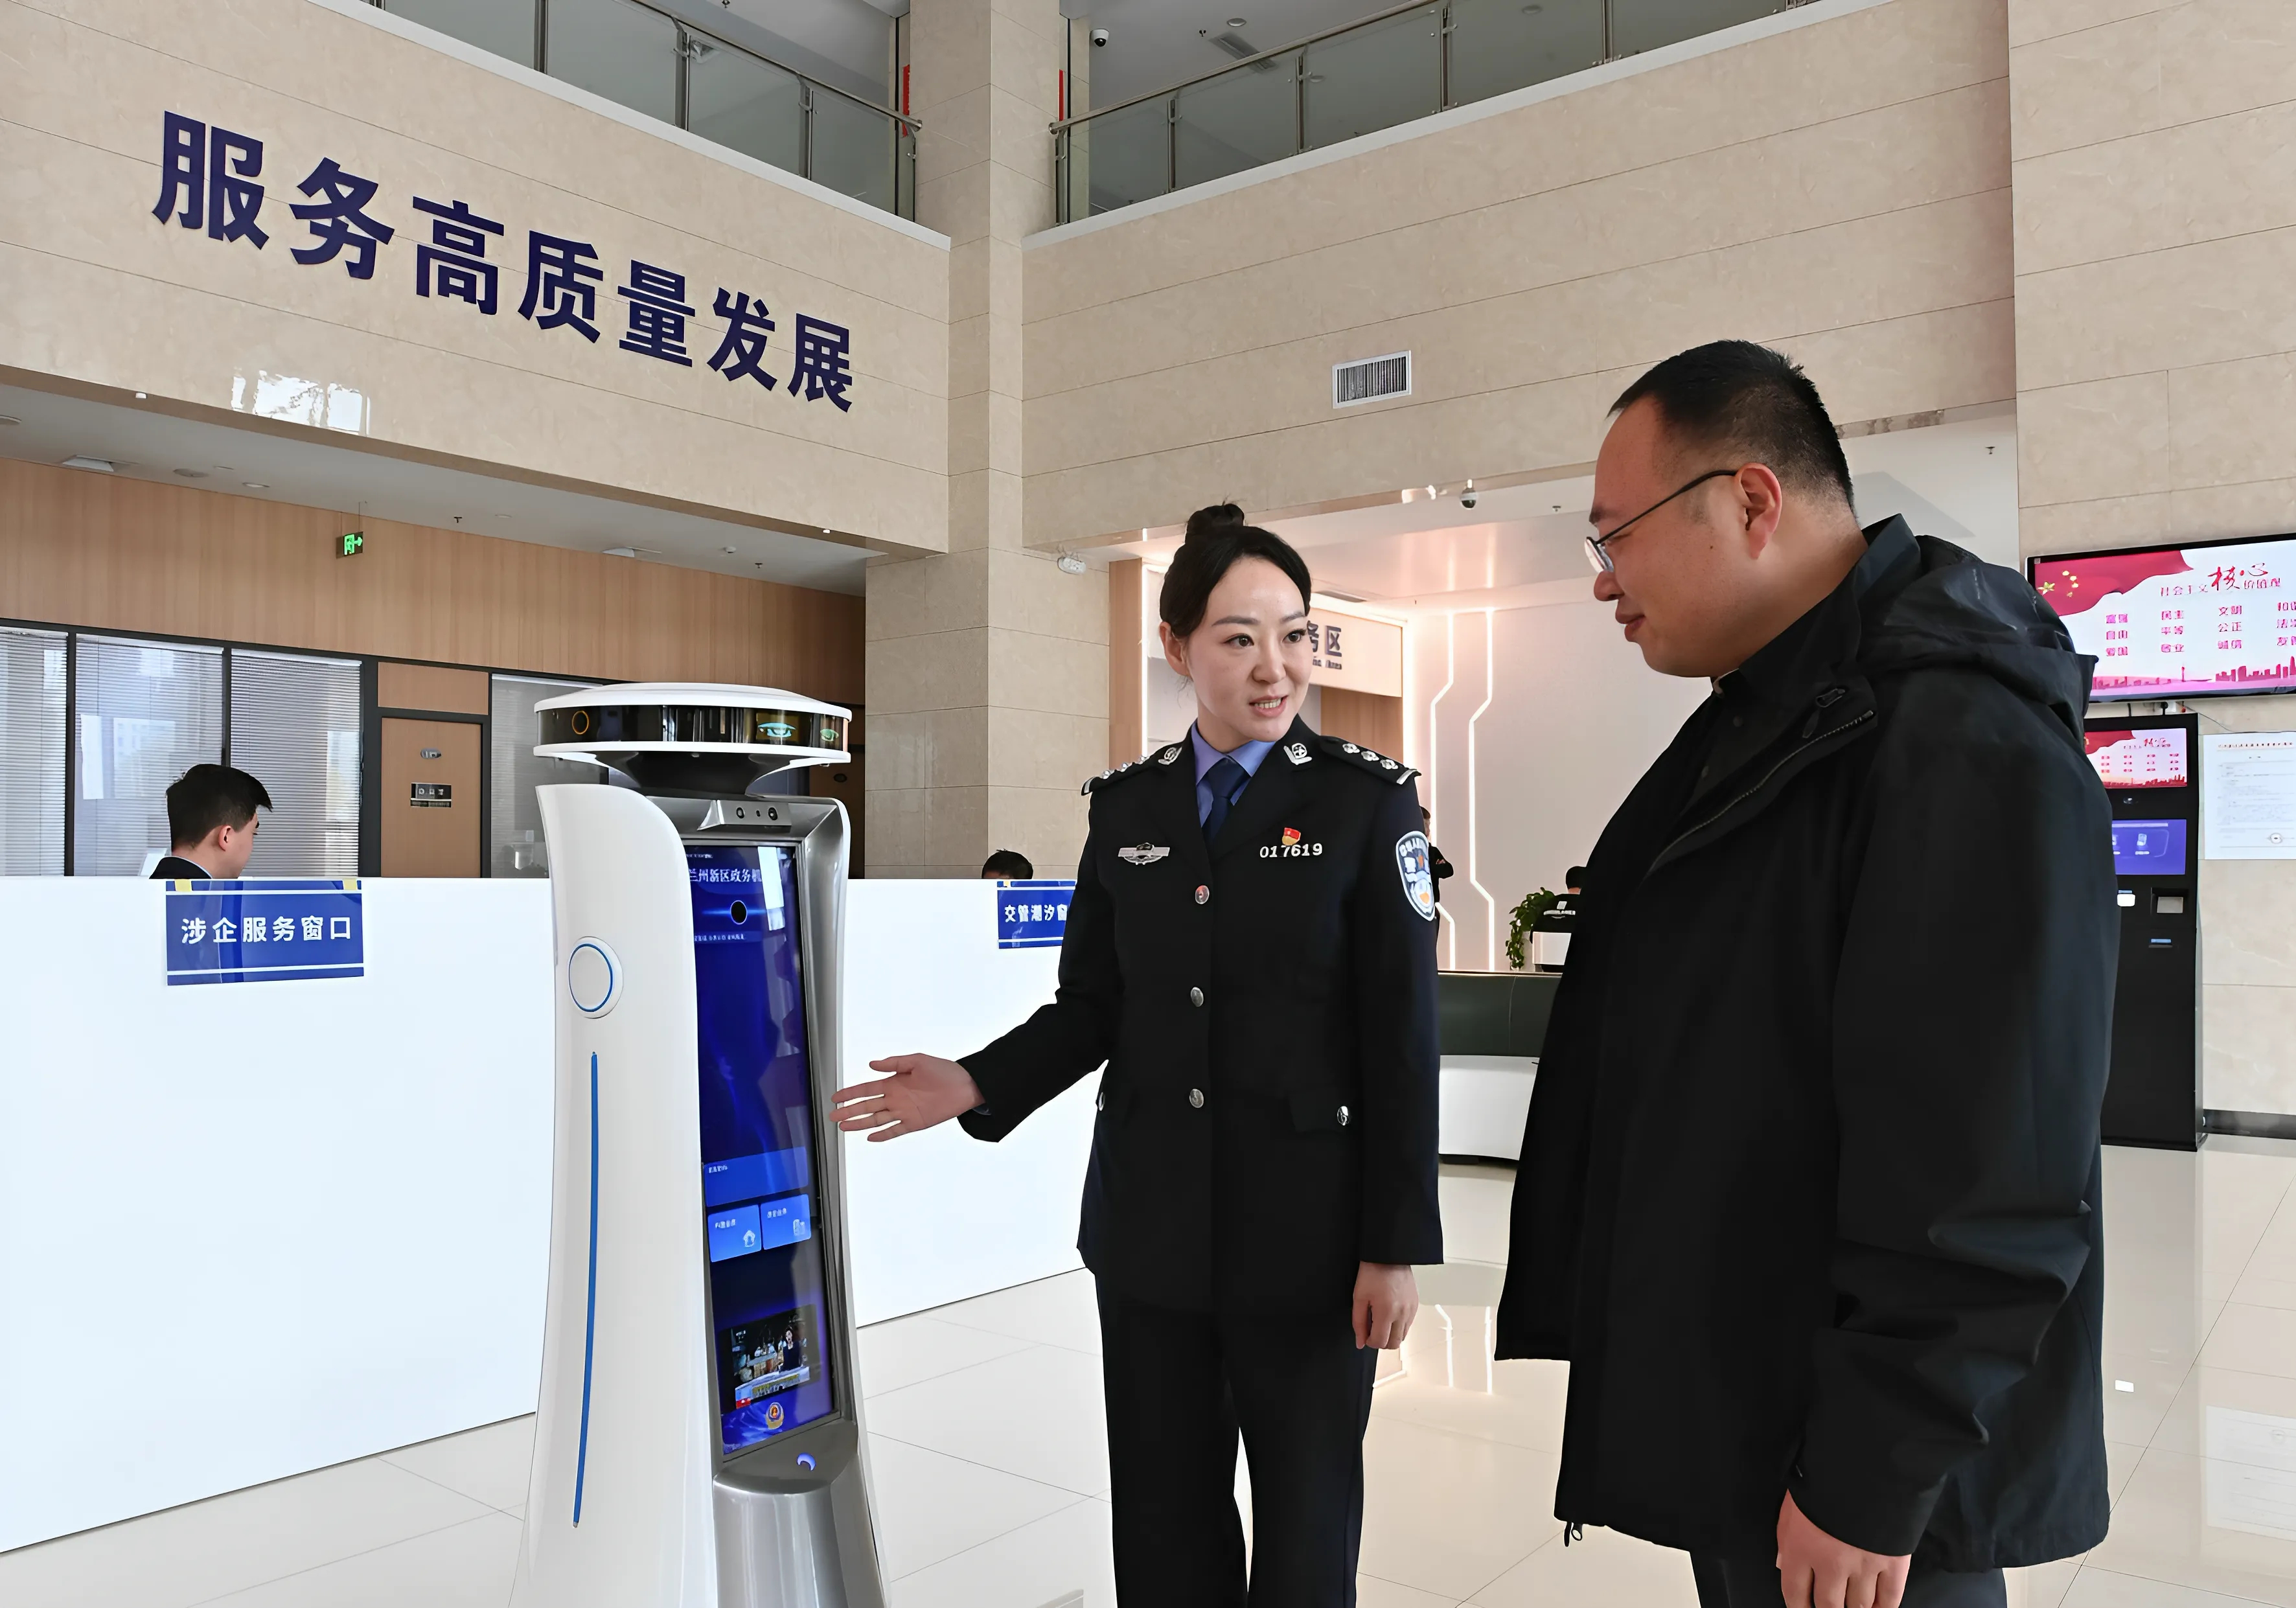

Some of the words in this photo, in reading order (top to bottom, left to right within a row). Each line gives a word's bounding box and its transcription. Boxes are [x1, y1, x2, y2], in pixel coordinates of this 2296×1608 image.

[152, 111, 853, 413] 服务高质量发展
[1259, 843, 1323, 858] 017619
[181, 915, 352, 945] 涉企服务窗口
